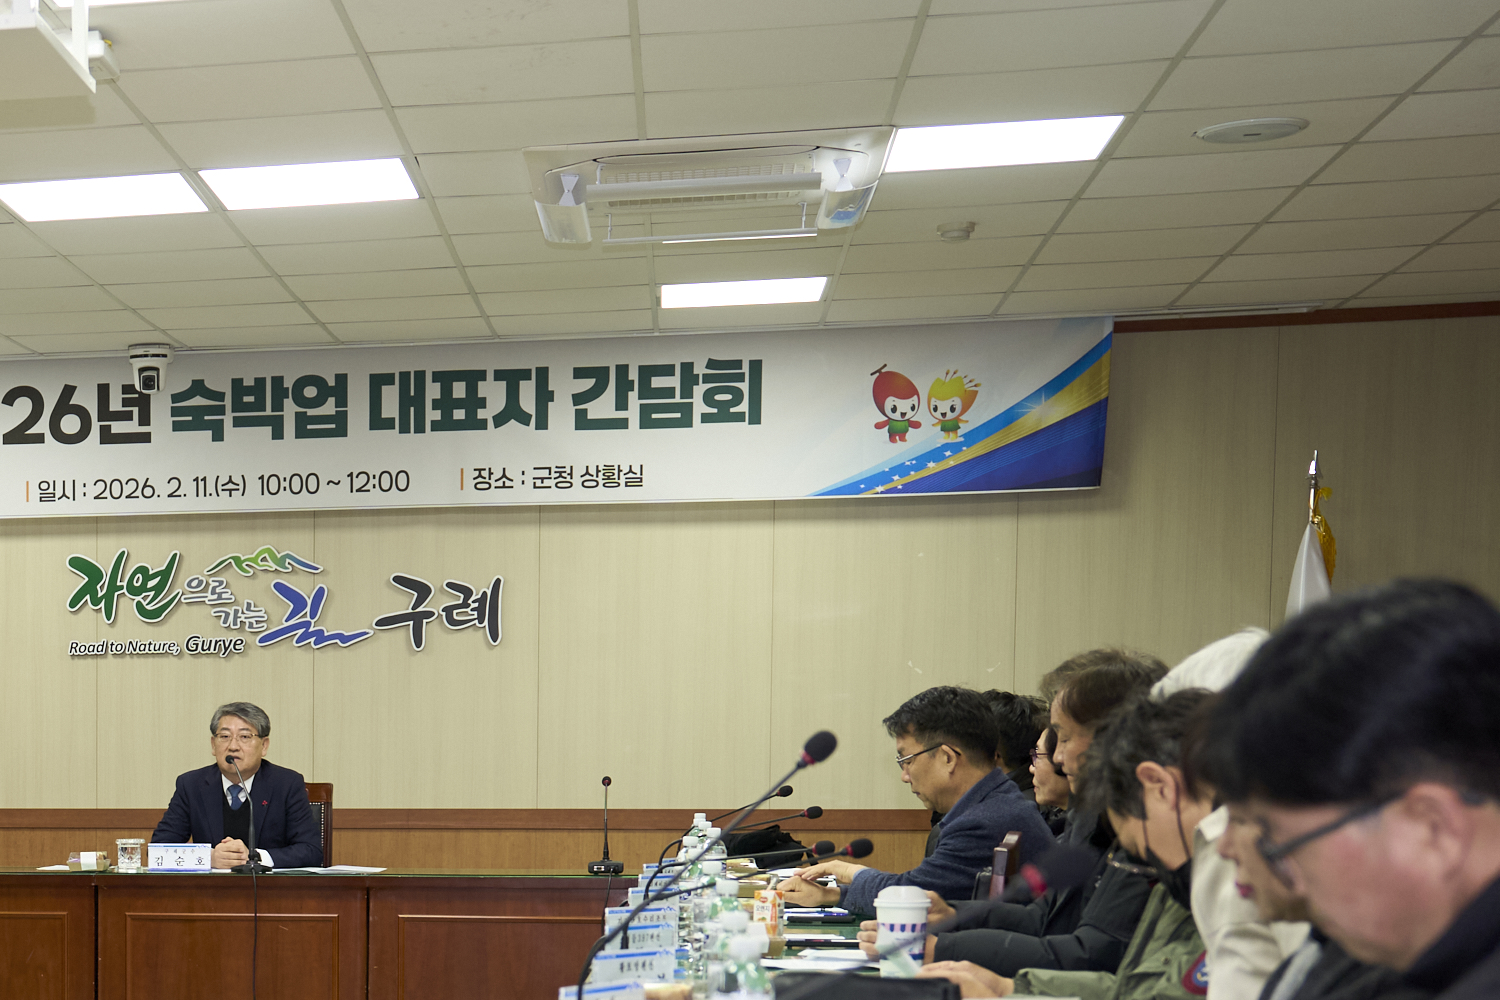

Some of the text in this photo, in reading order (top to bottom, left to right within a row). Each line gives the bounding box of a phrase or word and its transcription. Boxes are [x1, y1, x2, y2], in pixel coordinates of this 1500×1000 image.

[170, 372, 349, 442] 숙박업
[368, 366, 555, 434] 대표자
[571, 357, 763, 431] 간담회
[258, 472, 320, 496] 10:00
[346, 469, 410, 494] 12:00
[532, 465, 574, 490] 군청
[580, 464, 643, 489] 상황실
[374, 573, 502, 650] 구례
[68, 635, 245, 658] Road to Nature, Gurye
